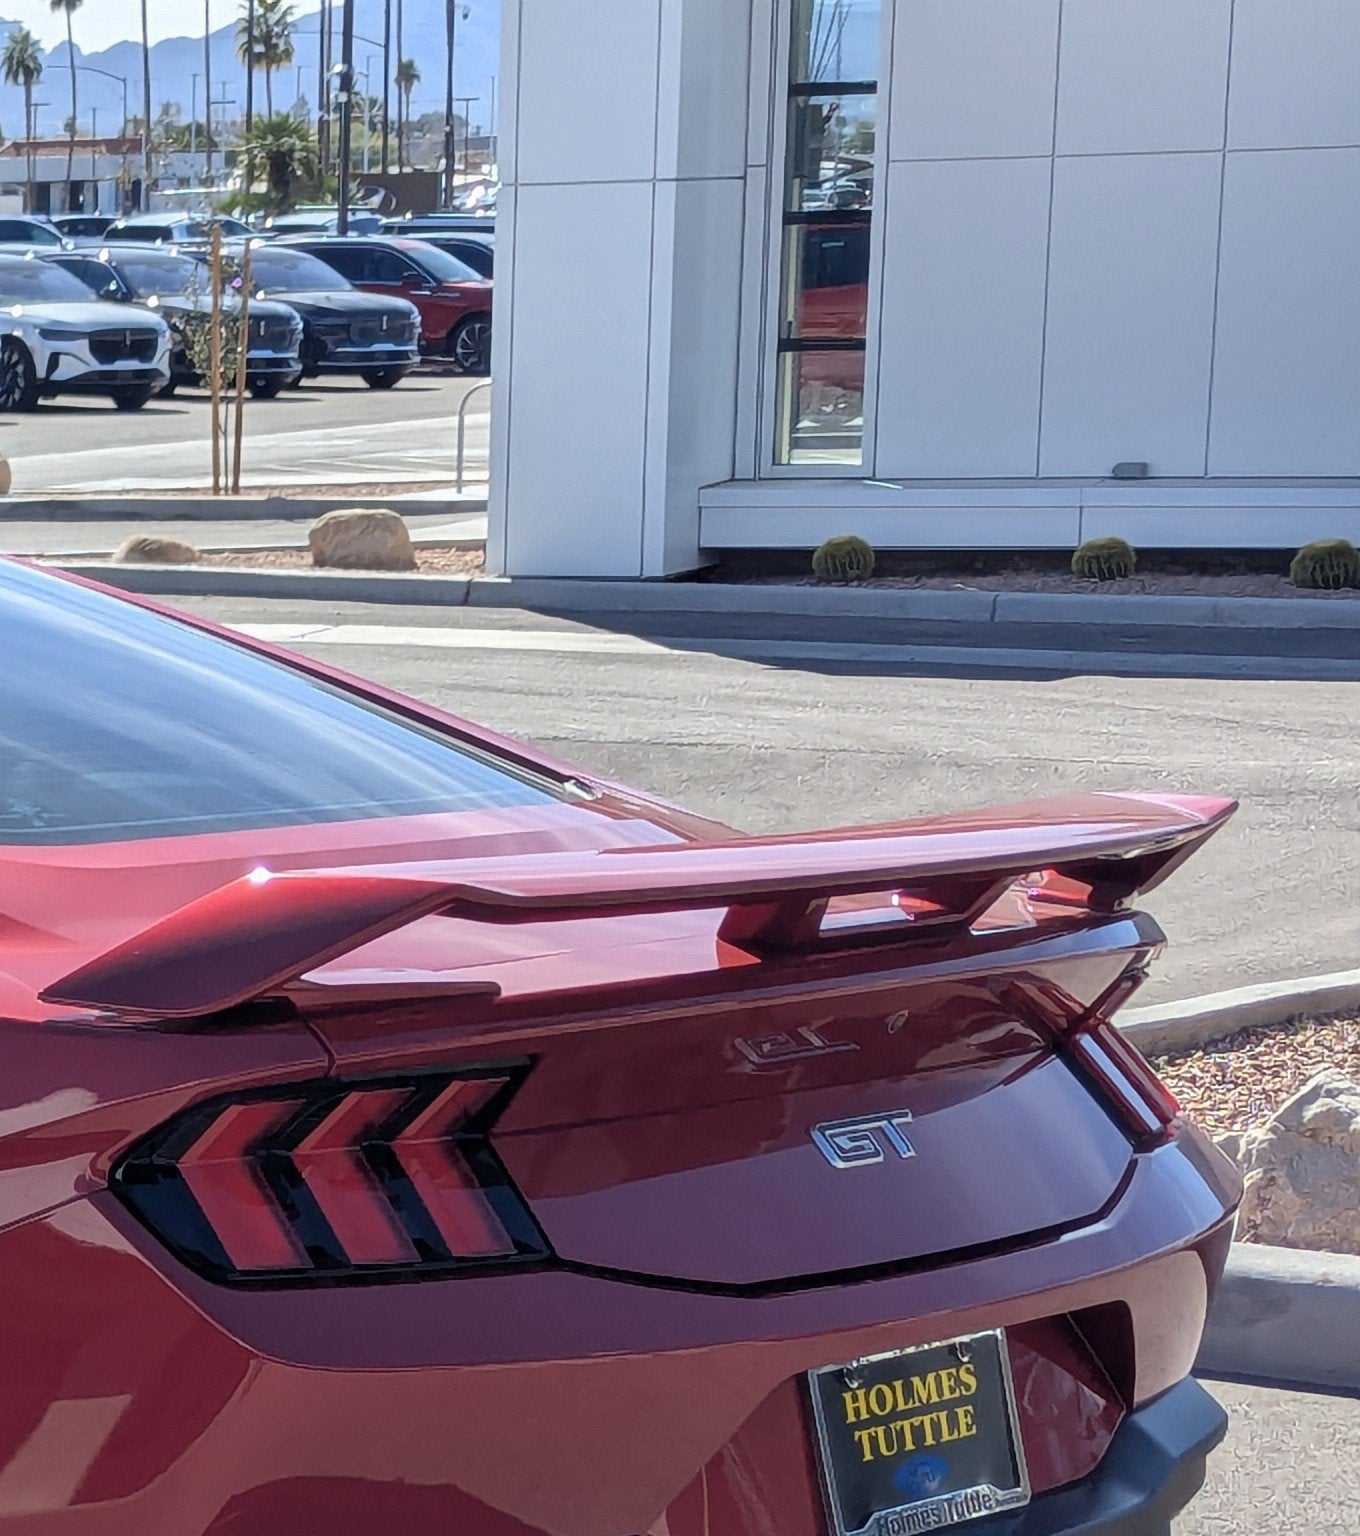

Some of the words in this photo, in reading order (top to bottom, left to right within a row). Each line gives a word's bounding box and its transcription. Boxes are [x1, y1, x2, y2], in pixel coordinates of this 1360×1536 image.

[810, 1108, 917, 1169] GT
[841, 1362, 978, 1425] HOLMES
[853, 1405, 977, 1462] TUTTLE
